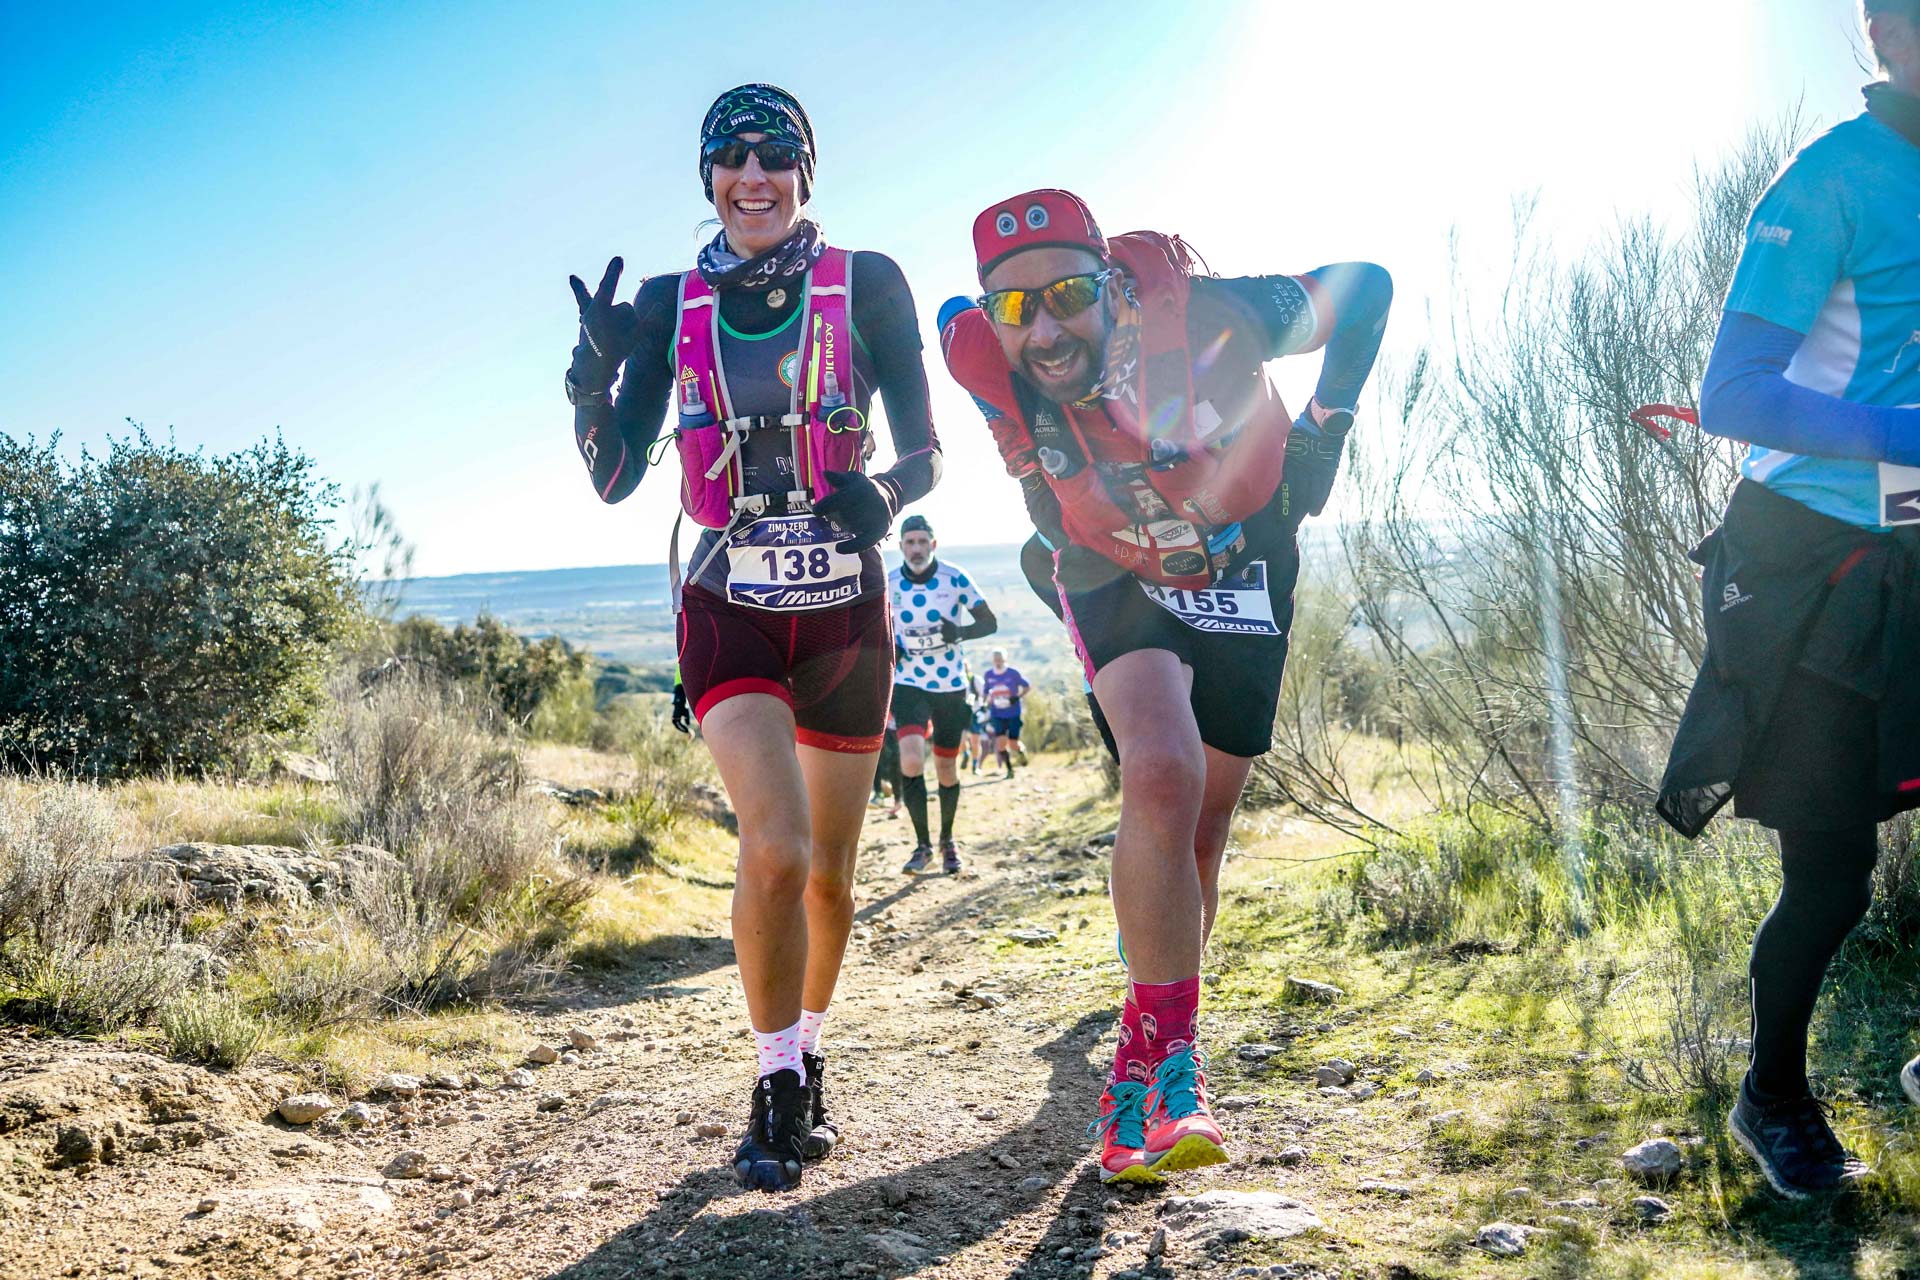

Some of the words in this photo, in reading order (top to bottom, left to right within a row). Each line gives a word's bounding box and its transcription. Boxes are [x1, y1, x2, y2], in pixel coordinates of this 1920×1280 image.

[1271, 295, 1289, 325] GYM
[767, 523, 787, 533] ZIMA
[789, 521, 809, 531] ZERO
[761, 547, 831, 581] 138
[1169, 589, 1239, 615] 155
[918, 636, 933, 648] 93
